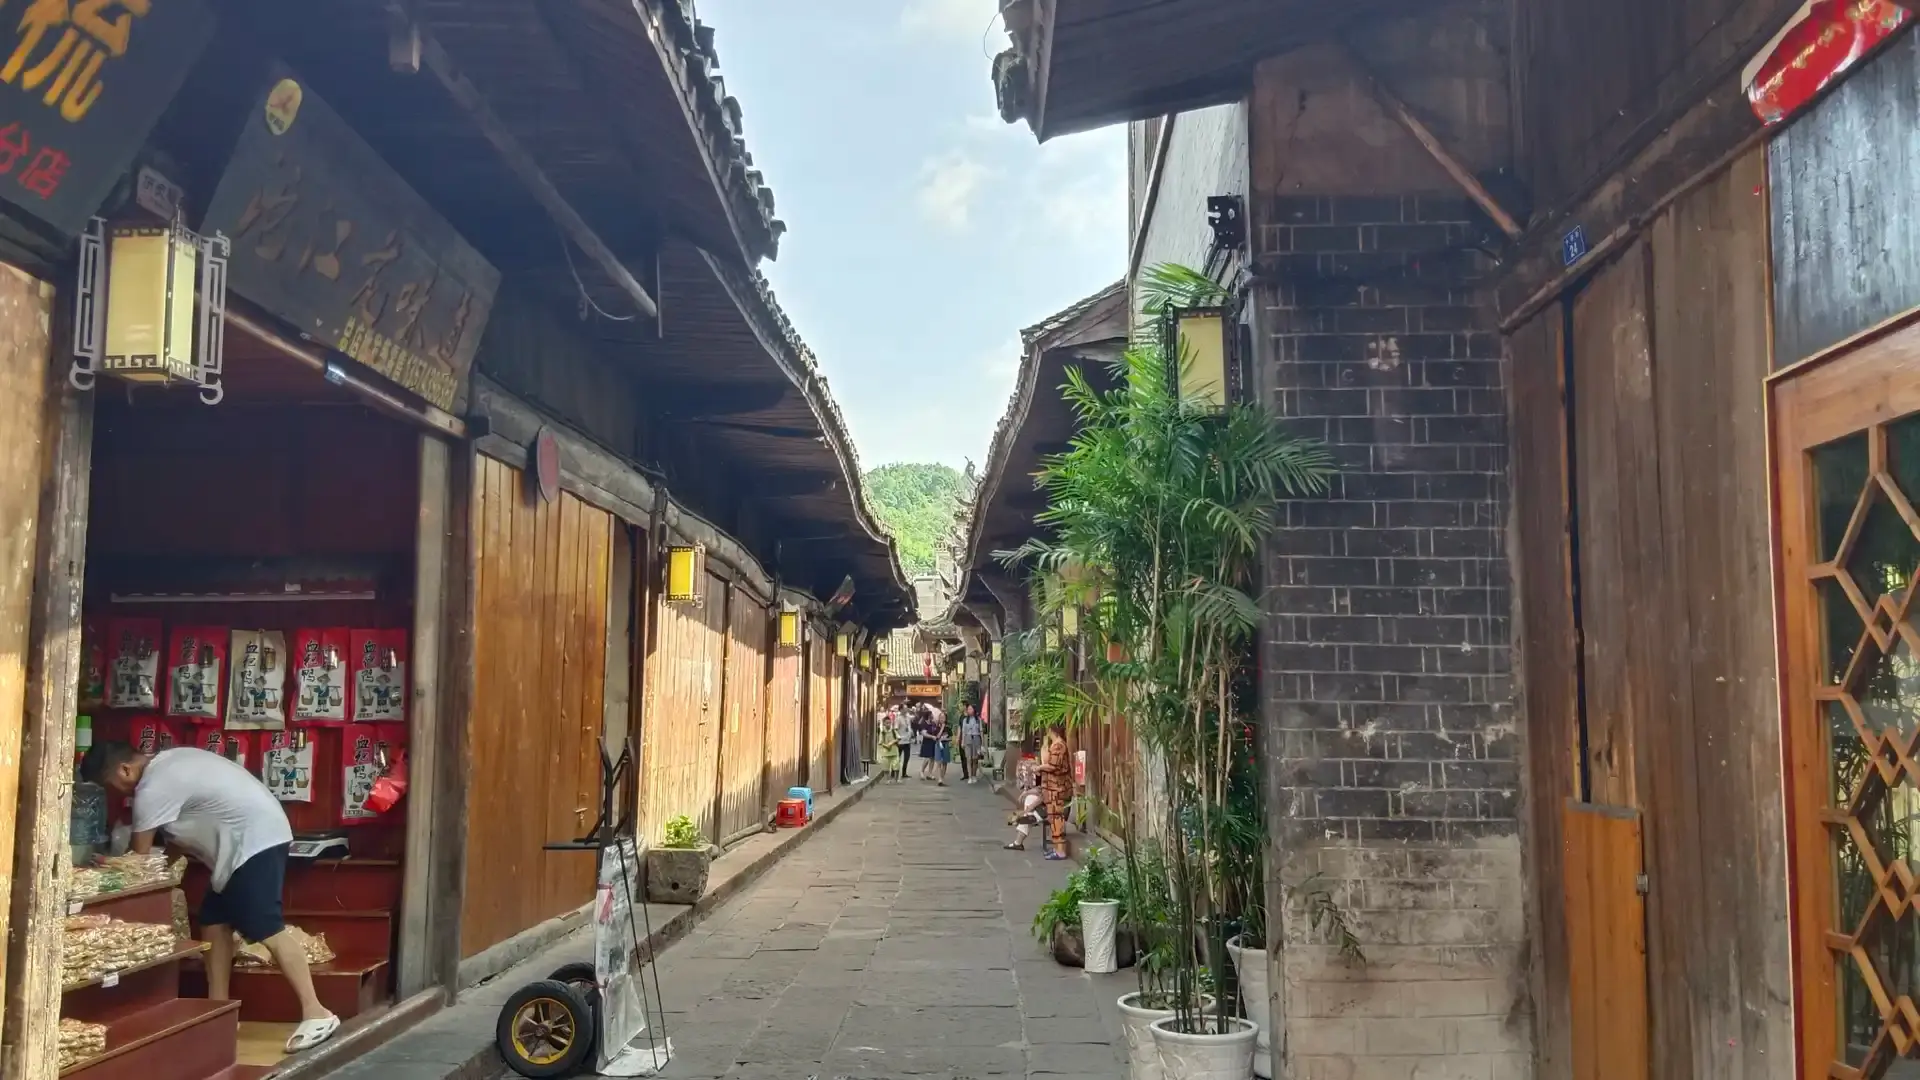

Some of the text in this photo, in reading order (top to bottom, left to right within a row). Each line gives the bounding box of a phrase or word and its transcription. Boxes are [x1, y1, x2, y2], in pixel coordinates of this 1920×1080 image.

[0, 120, 71, 200] 分店
[301, 639, 319, 683] 血粑鸭
